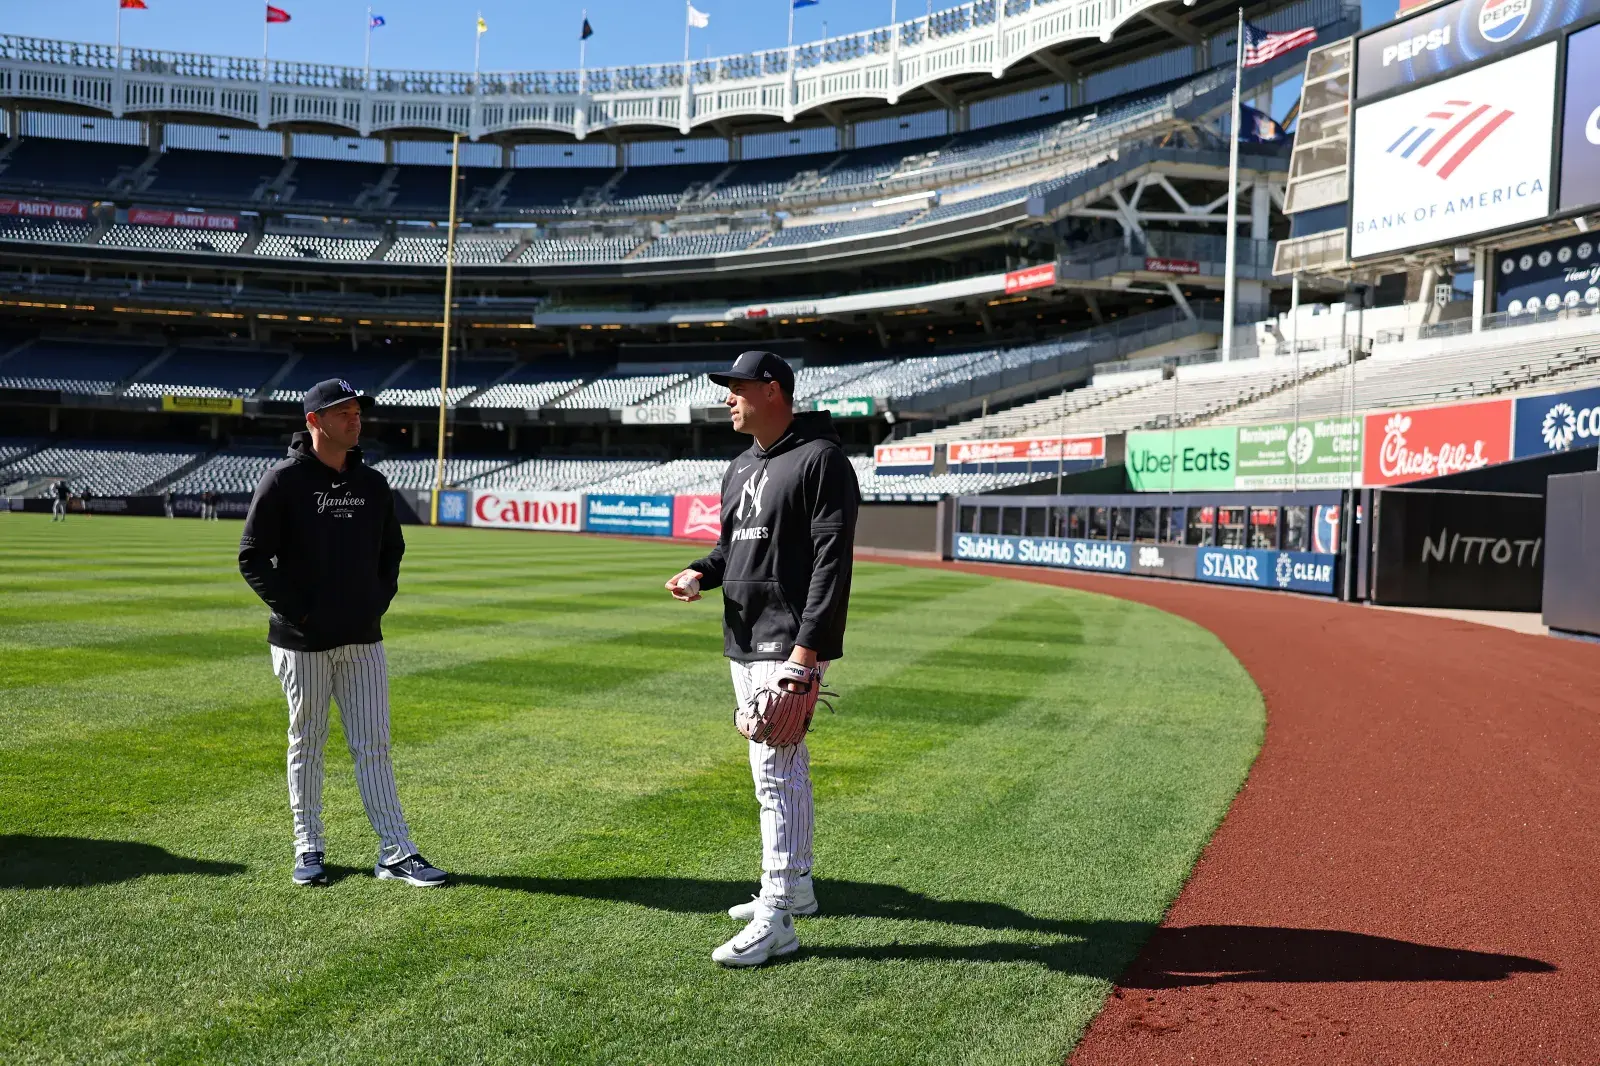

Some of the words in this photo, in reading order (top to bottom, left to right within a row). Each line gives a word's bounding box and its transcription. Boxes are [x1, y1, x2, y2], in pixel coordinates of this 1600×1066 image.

[1482, 2, 1528, 24] PEPSI
[1383, 25, 1450, 67] PEPSI
[18, 203, 52, 214] PARTY
[54, 206, 83, 217] DECK
[1356, 212, 1407, 234] BANK
[1414, 204, 1438, 222] OF
[1445, 178, 1544, 216] AMERICA
[174, 214, 206, 226] PARTY
[207, 218, 235, 228] DECK
[338, 379, 354, 393] NY
[636, 407, 676, 422] ORIS
[1131, 450, 1177, 474] Uber
[1183, 447, 1230, 471] Eats
[1380, 428, 1488, 477] Chick-fil-A
[313, 491, 365, 513] Yankees
[736, 467, 769, 521] NY
[475, 494, 577, 525] Canon
[957, 536, 1014, 560] StubHub
[1018, 539, 1070, 565] StubHub
[1073, 542, 1126, 569] StubHub
[1202, 552, 1260, 582] STARR
[1294, 562, 1331, 583] CLEAR
